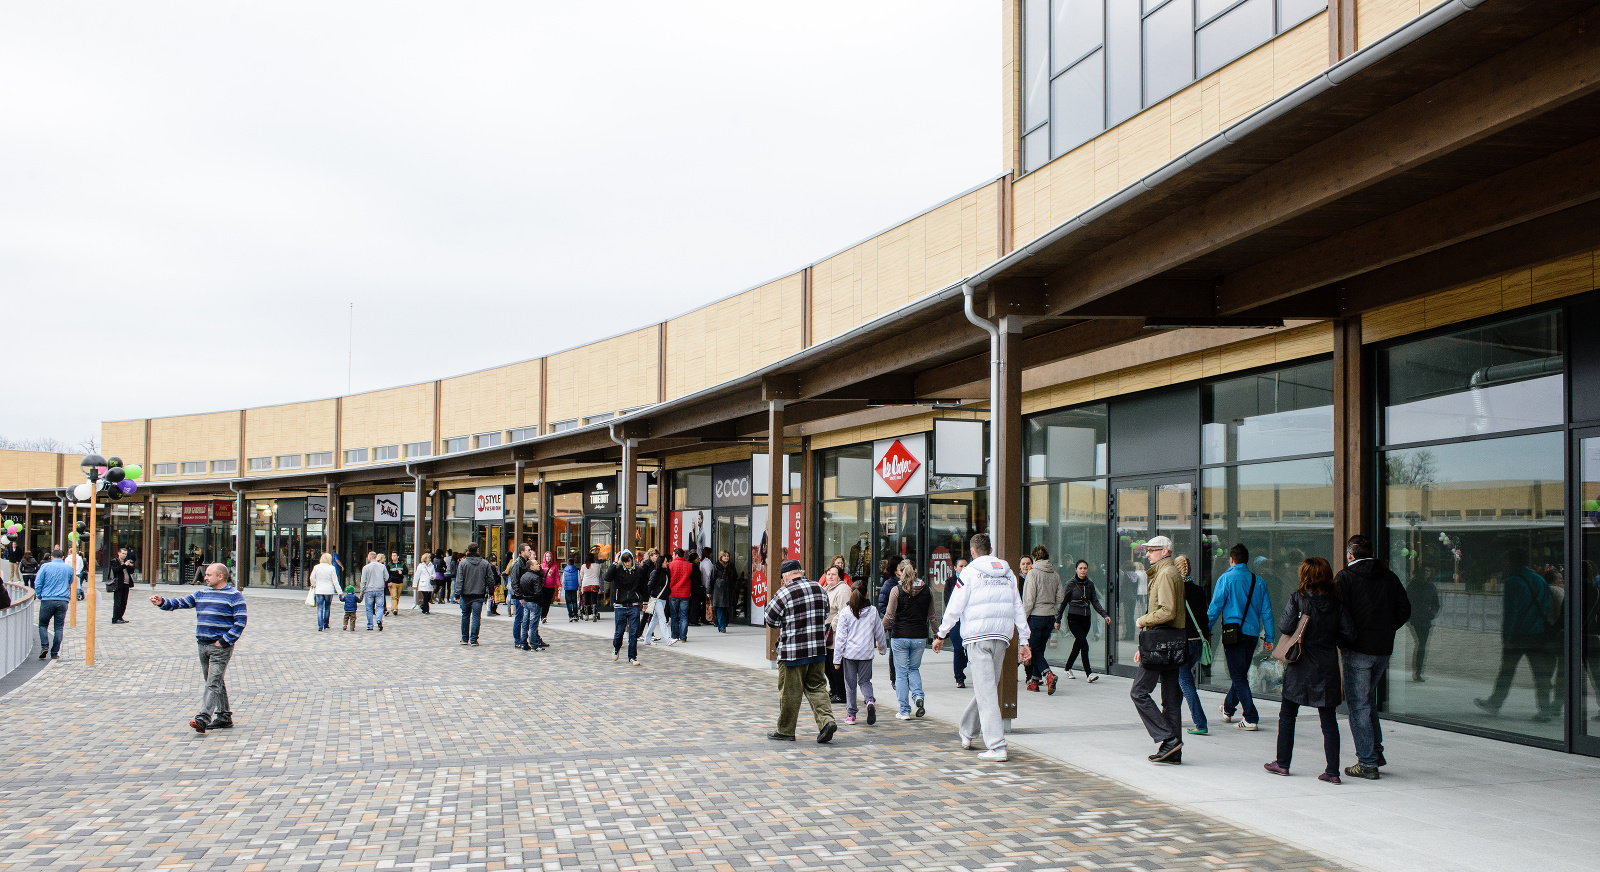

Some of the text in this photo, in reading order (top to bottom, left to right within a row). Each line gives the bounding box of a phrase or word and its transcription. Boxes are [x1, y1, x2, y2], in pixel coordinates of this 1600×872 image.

[882, 457, 891, 479] Lee
[715, 477, 749, 498] ecco
[477, 494, 502, 509] IN STYLE
